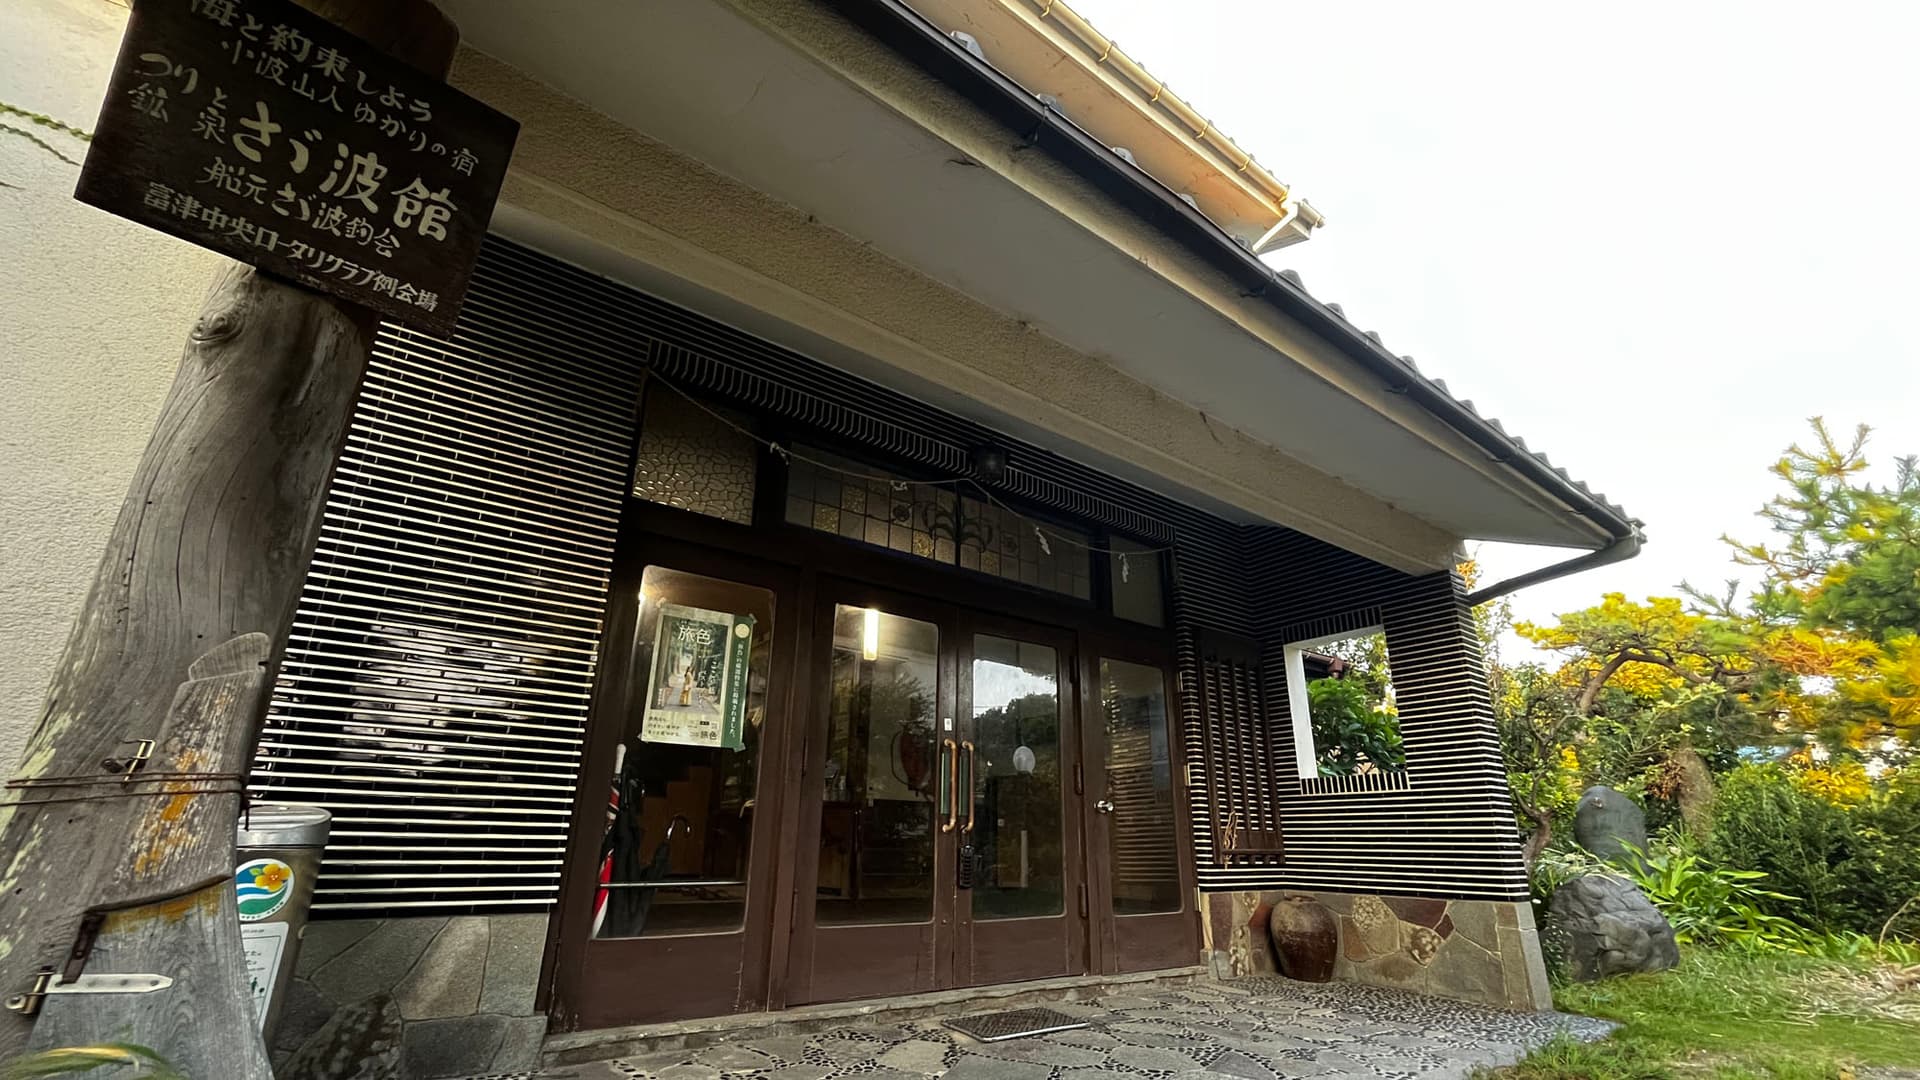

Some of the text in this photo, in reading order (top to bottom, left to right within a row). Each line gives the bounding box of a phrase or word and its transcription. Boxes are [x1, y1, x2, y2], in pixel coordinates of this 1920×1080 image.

[191, 0, 433, 122] 海と約束しよう
[678, 625, 713, 645] 旅色
